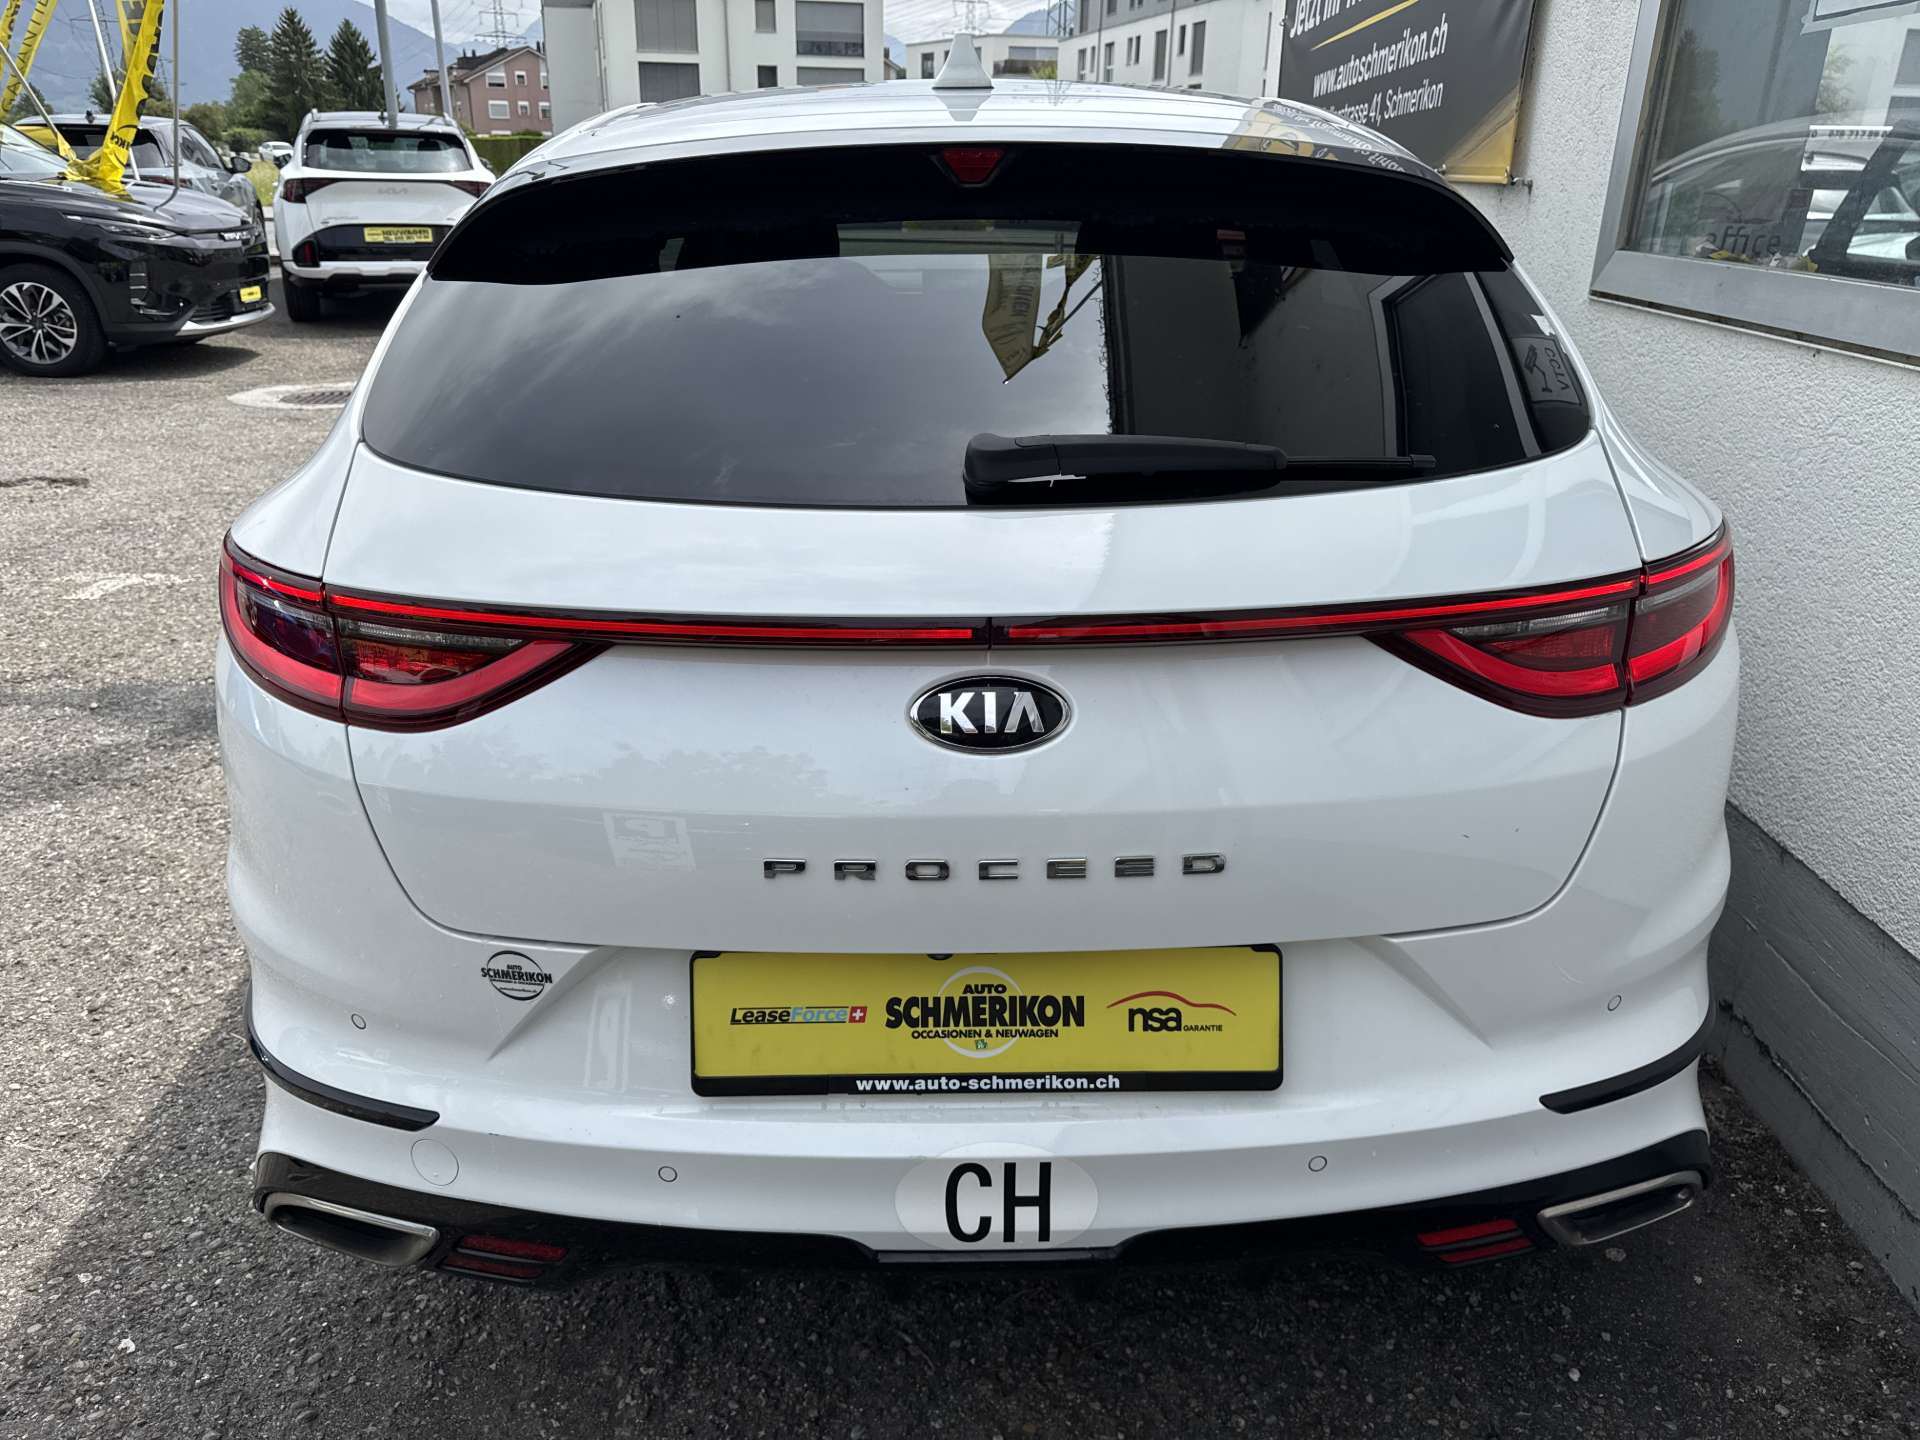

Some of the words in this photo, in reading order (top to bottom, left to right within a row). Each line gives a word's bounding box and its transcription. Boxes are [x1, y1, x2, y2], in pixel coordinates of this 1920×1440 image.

[1312, 12, 1448, 98] www.autoschmerikon.ch
[1384, 78, 1443, 119] Schmerikon
[937, 690, 1046, 735] KIA
[763, 853, 1226, 881] PROCEED
[481, 967, 553, 984] SCHMERIKON
[962, 983, 1008, 995] AUTO
[730, 1006, 849, 1025] LeaseForce
[885, 995, 1085, 1029] SCHMERIKON
[1127, 1006, 1182, 1033] nsa
[1183, 1024, 1223, 1033] GARANTIE
[911, 1028, 982, 1040] OCCASIONEN
[984, 1029, 994, 1039] &
[995, 1028, 1059, 1039] NEUWAGEN
[855, 1075, 1121, 1092] www.auto-schmerikon.ch
[945, 1161, 1052, 1243] CH
